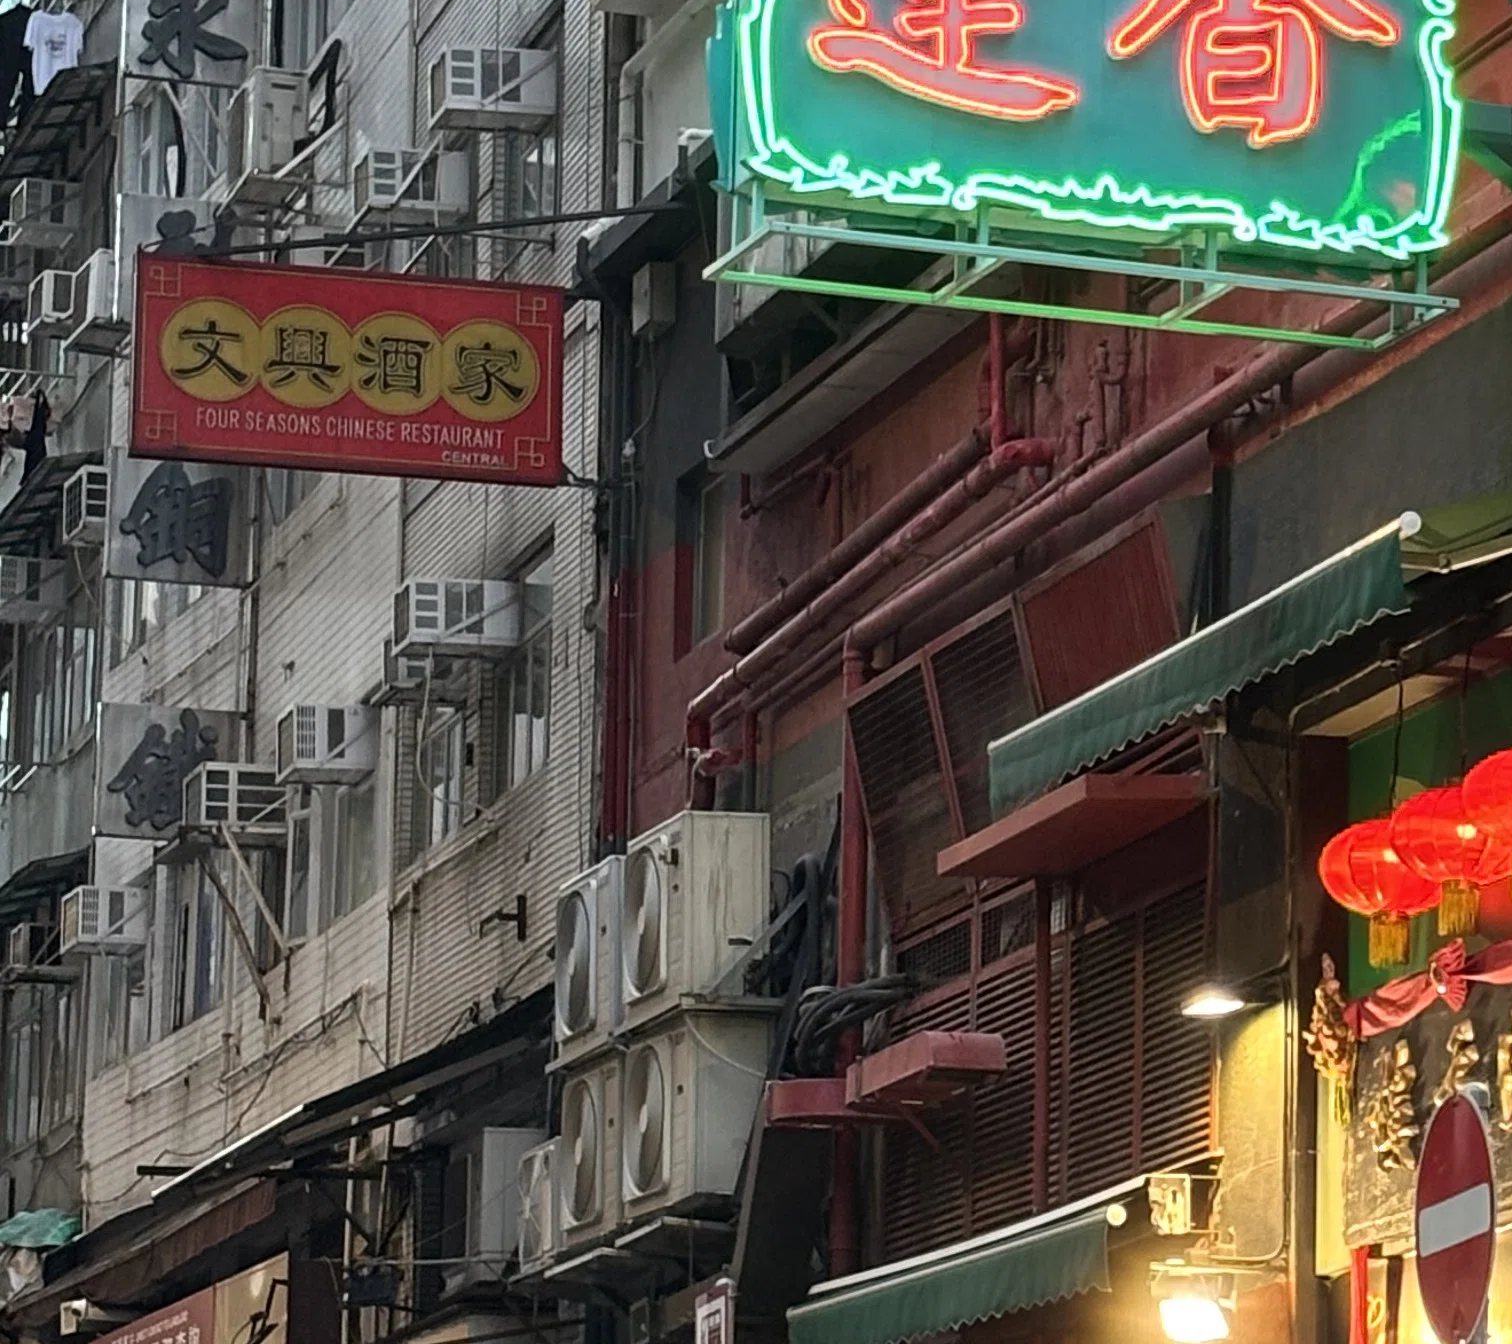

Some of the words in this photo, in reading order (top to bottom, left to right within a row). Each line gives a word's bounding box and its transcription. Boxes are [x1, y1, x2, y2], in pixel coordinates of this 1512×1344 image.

[174, 318, 528, 403] 文興酒家
[196, 407, 240, 430] FOUR
[244, 410, 322, 436] SEASONS
[325, 416, 396, 442] CHINESE
[400, 422, 505, 450] RESTAURANT
[440, 450, 508, 468] CENTRAL
